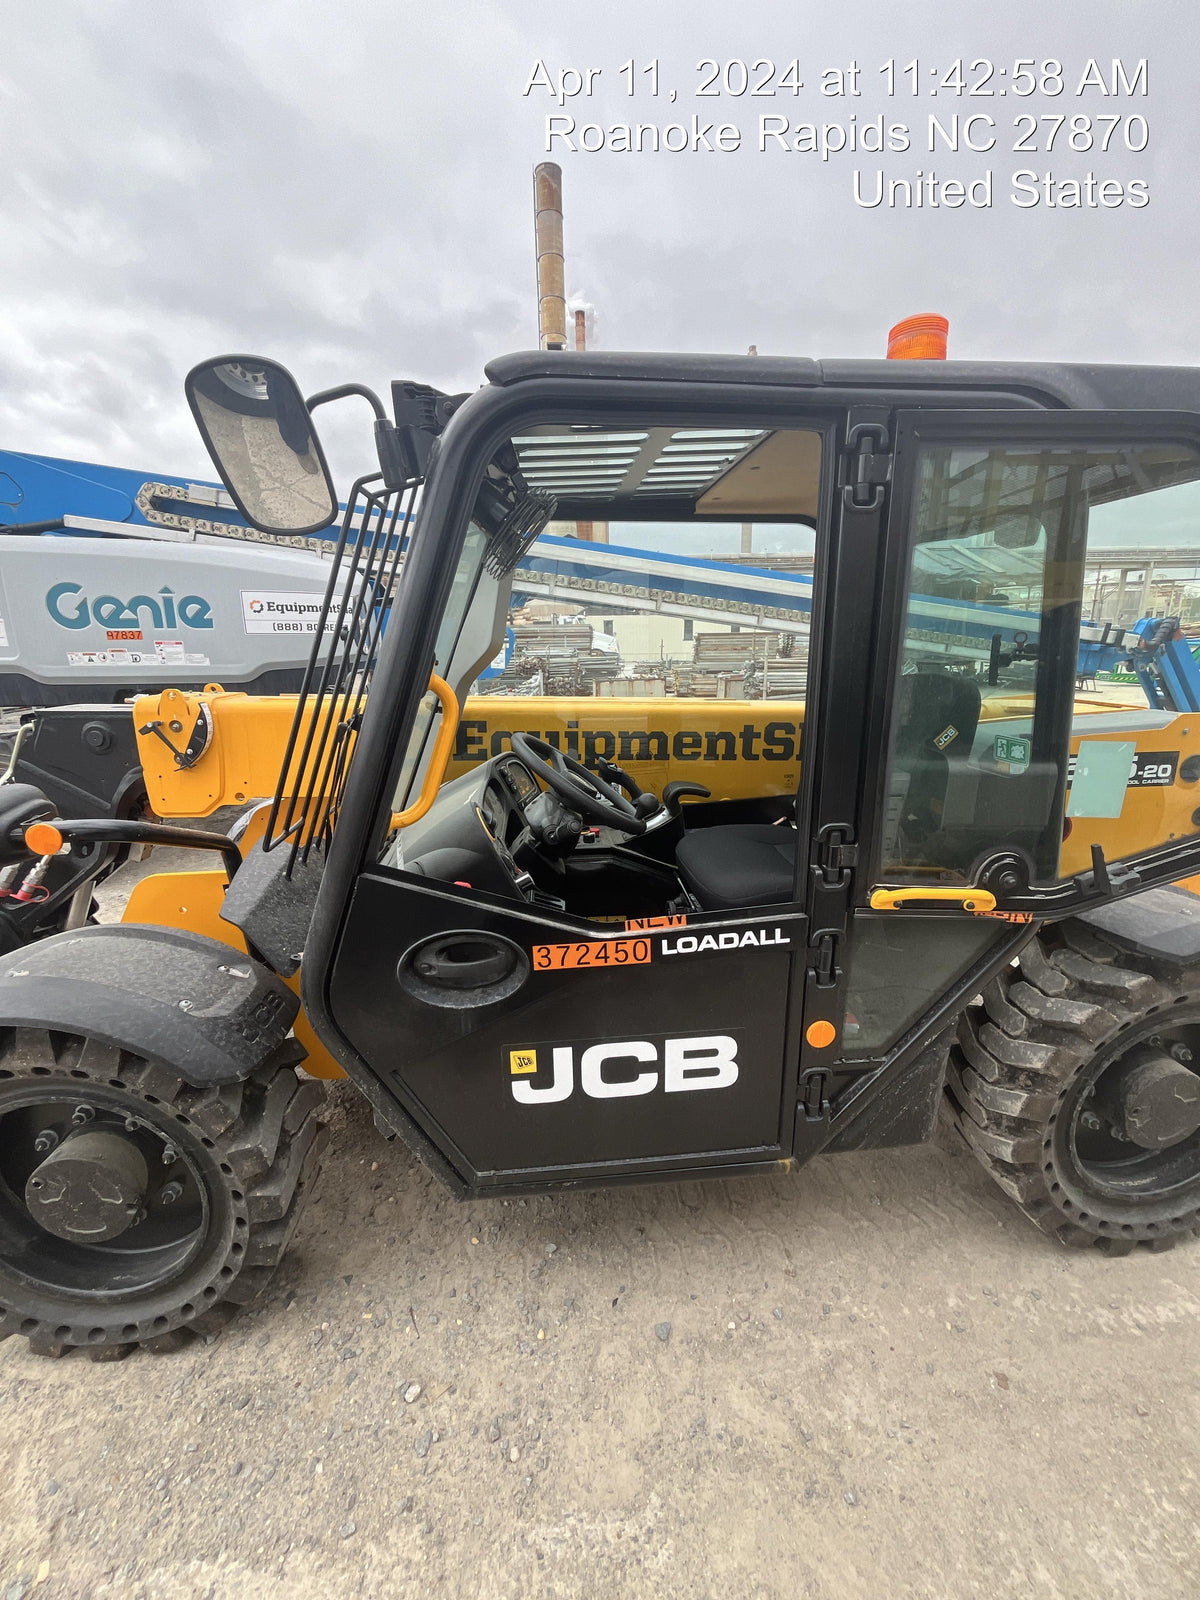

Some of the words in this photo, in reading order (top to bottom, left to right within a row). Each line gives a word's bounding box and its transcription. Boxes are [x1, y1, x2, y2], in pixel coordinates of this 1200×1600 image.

[46, 581, 214, 630] Genie
[106, 630, 142, 640] 97837
[272, 622, 303, 631] (888)
[938, 728, 956, 745] JCB
[661, 928, 790, 955] LOADALL
[536, 939, 648, 968] 372450
[511, 1035, 739, 1104] JCB
[517, 1056, 533, 1068] JCB
